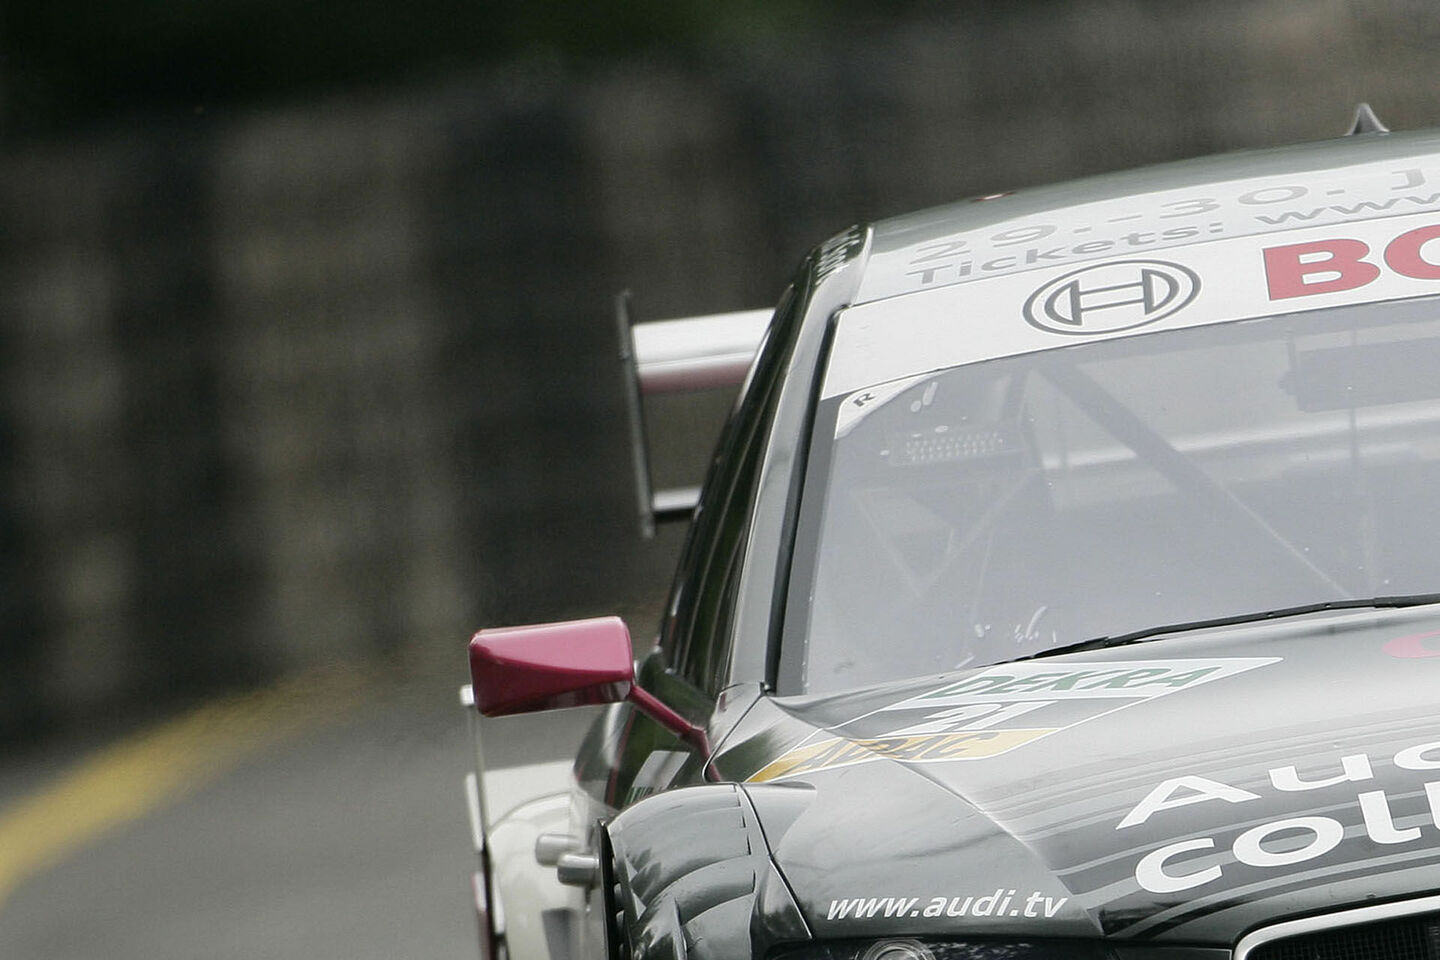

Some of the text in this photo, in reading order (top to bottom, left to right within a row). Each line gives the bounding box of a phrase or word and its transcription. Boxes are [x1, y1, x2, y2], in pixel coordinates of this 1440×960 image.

[906, 221, 1223, 284] Tickets:
[920, 666, 1224, 700] DEKRA
[826, 888, 1068, 921] www.audi.tv
